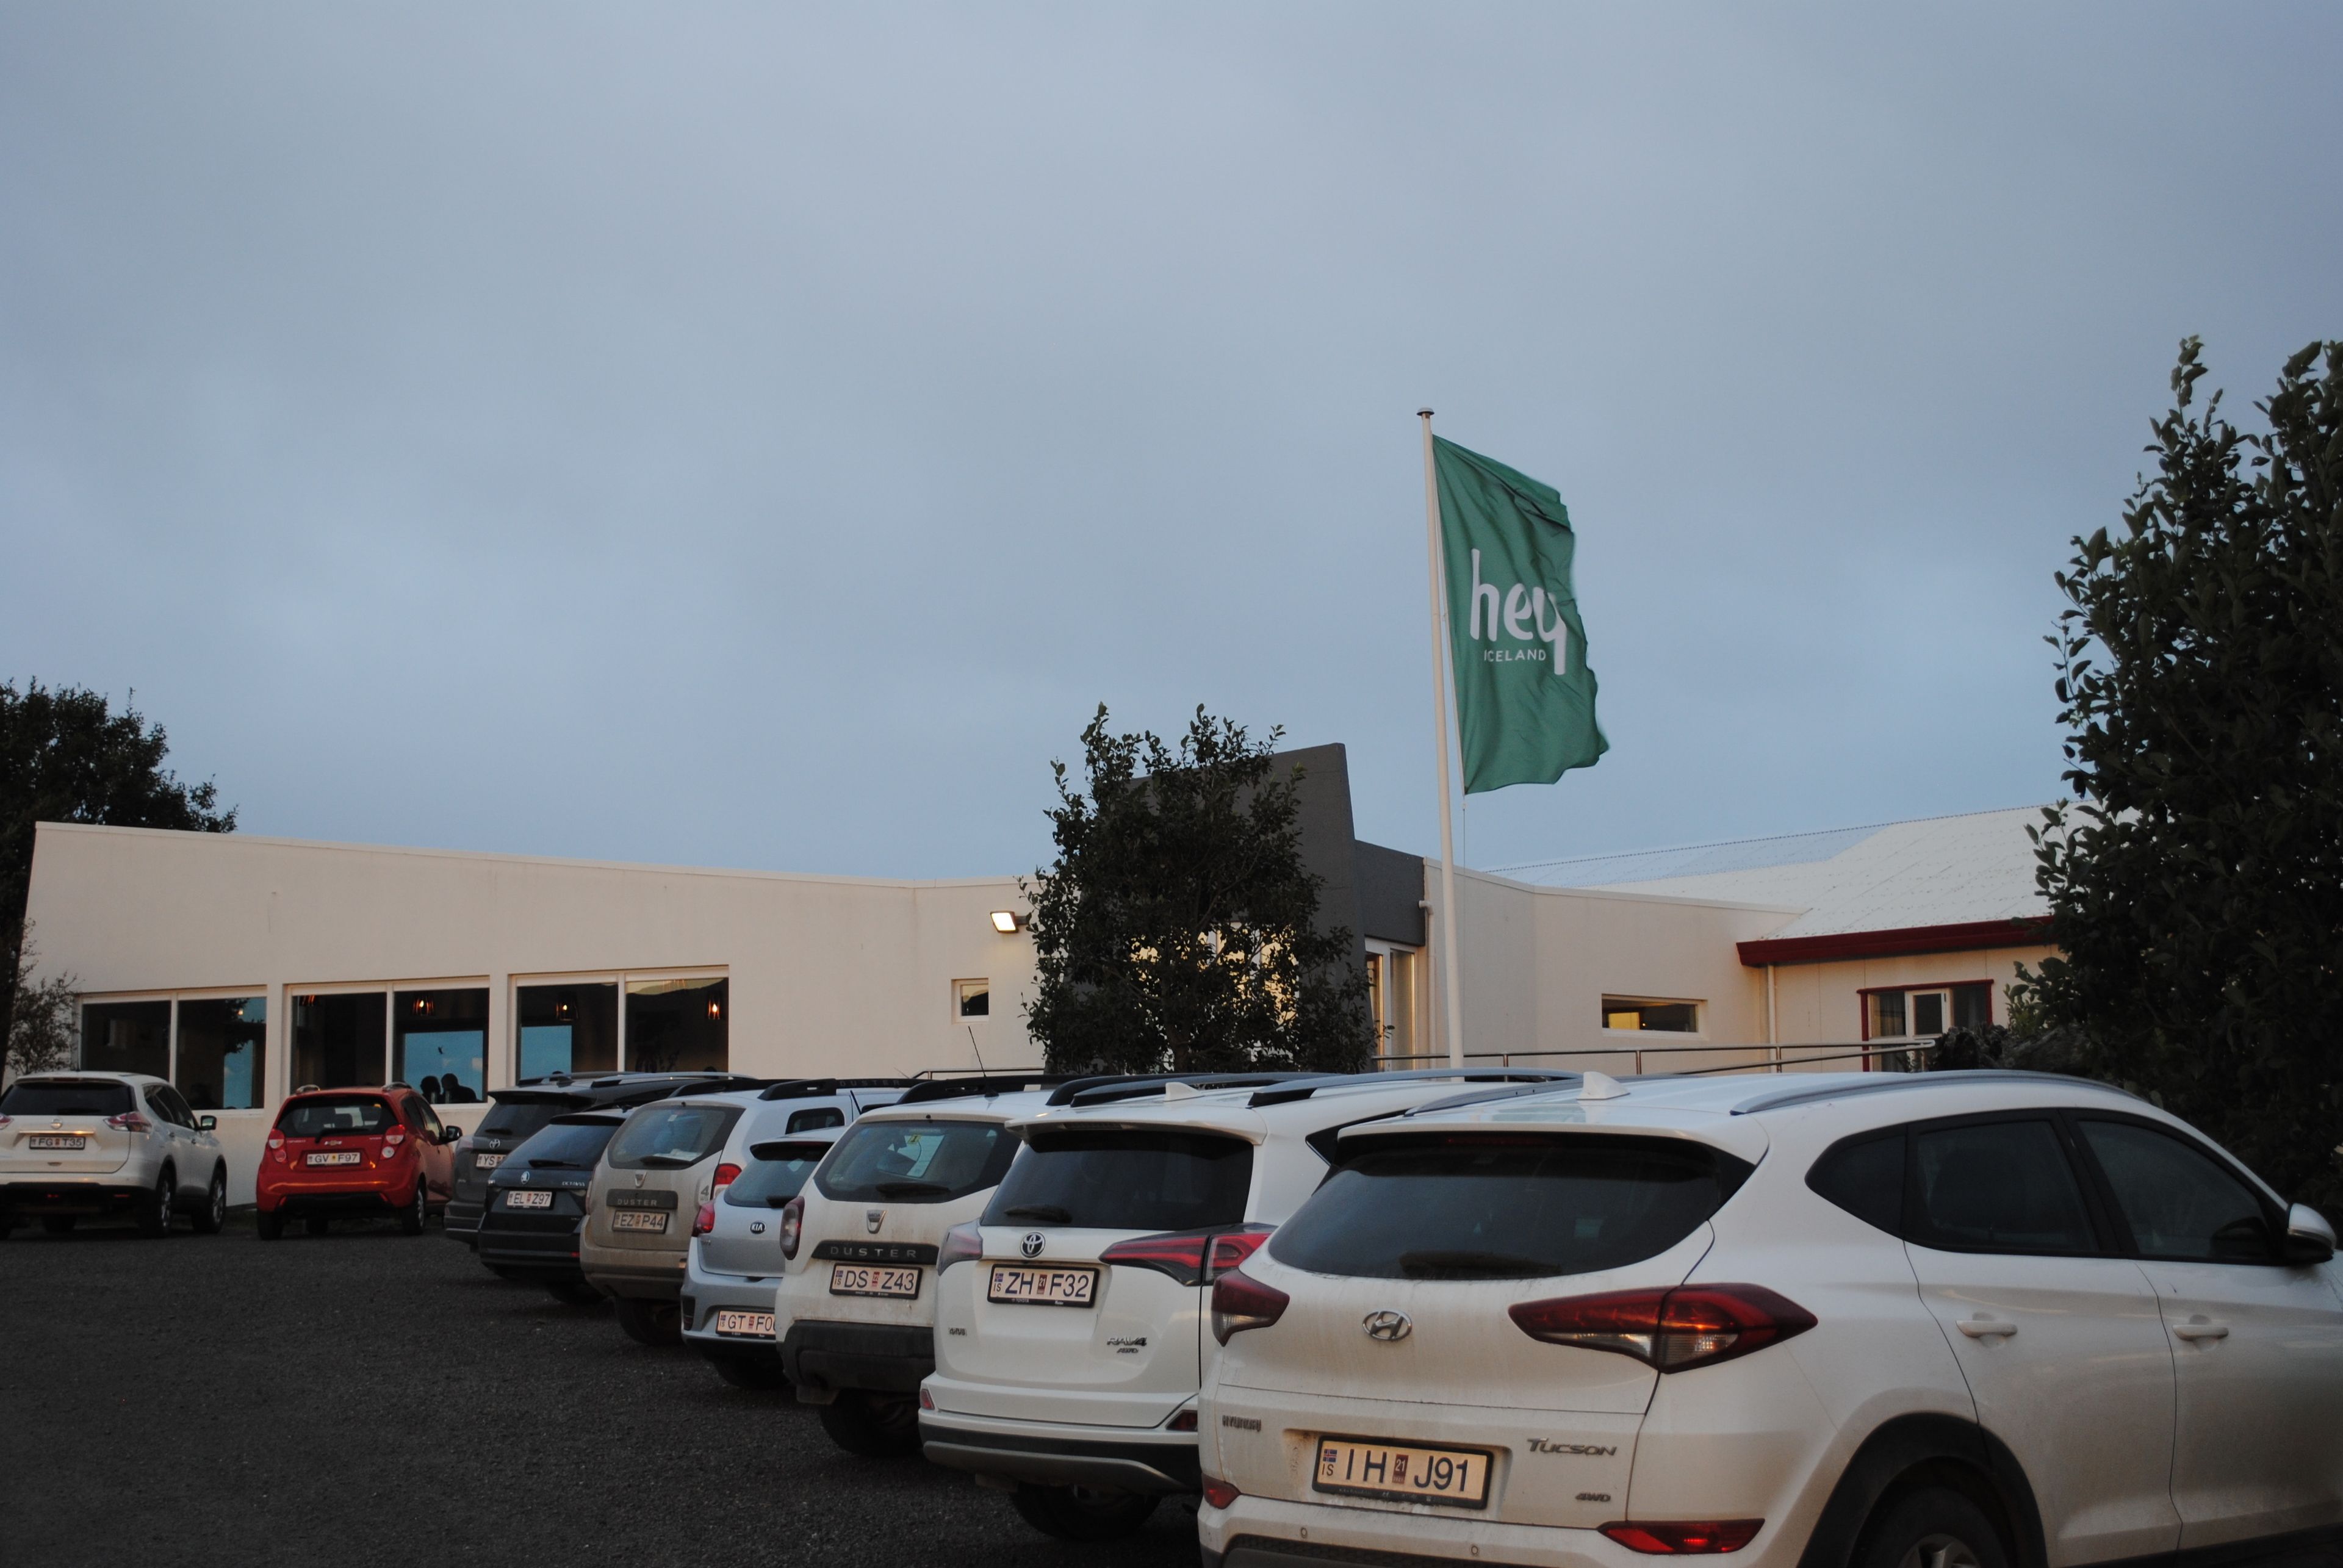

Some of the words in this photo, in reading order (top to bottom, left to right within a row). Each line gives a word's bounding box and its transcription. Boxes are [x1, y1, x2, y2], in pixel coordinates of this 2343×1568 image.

[1470, 548, 1567, 675] hey
[1484, 649, 1547, 662] ICELAND
[484, 1156, 495, 1165] YS
[514, 1193, 524, 1204] EL
[532, 1193, 550, 1204] Z97
[620, 1214, 635, 1226] EZ
[642, 1215, 663, 1228] P44
[830, 1246, 917, 1257] DUSTER
[844, 1270, 869, 1288] DS
[881, 1271, 915, 1290] Z43
[1005, 1272, 1034, 1295] ZH
[1049, 1274, 1089, 1297] F32
[728, 1315, 746, 1329] GT
[1322, 1462, 1334, 1476] IS
[1395, 1458, 1406, 1472] 21
[1414, 1455, 1469, 1492] J91
[1575, 1493, 1611, 1502] 4WD
